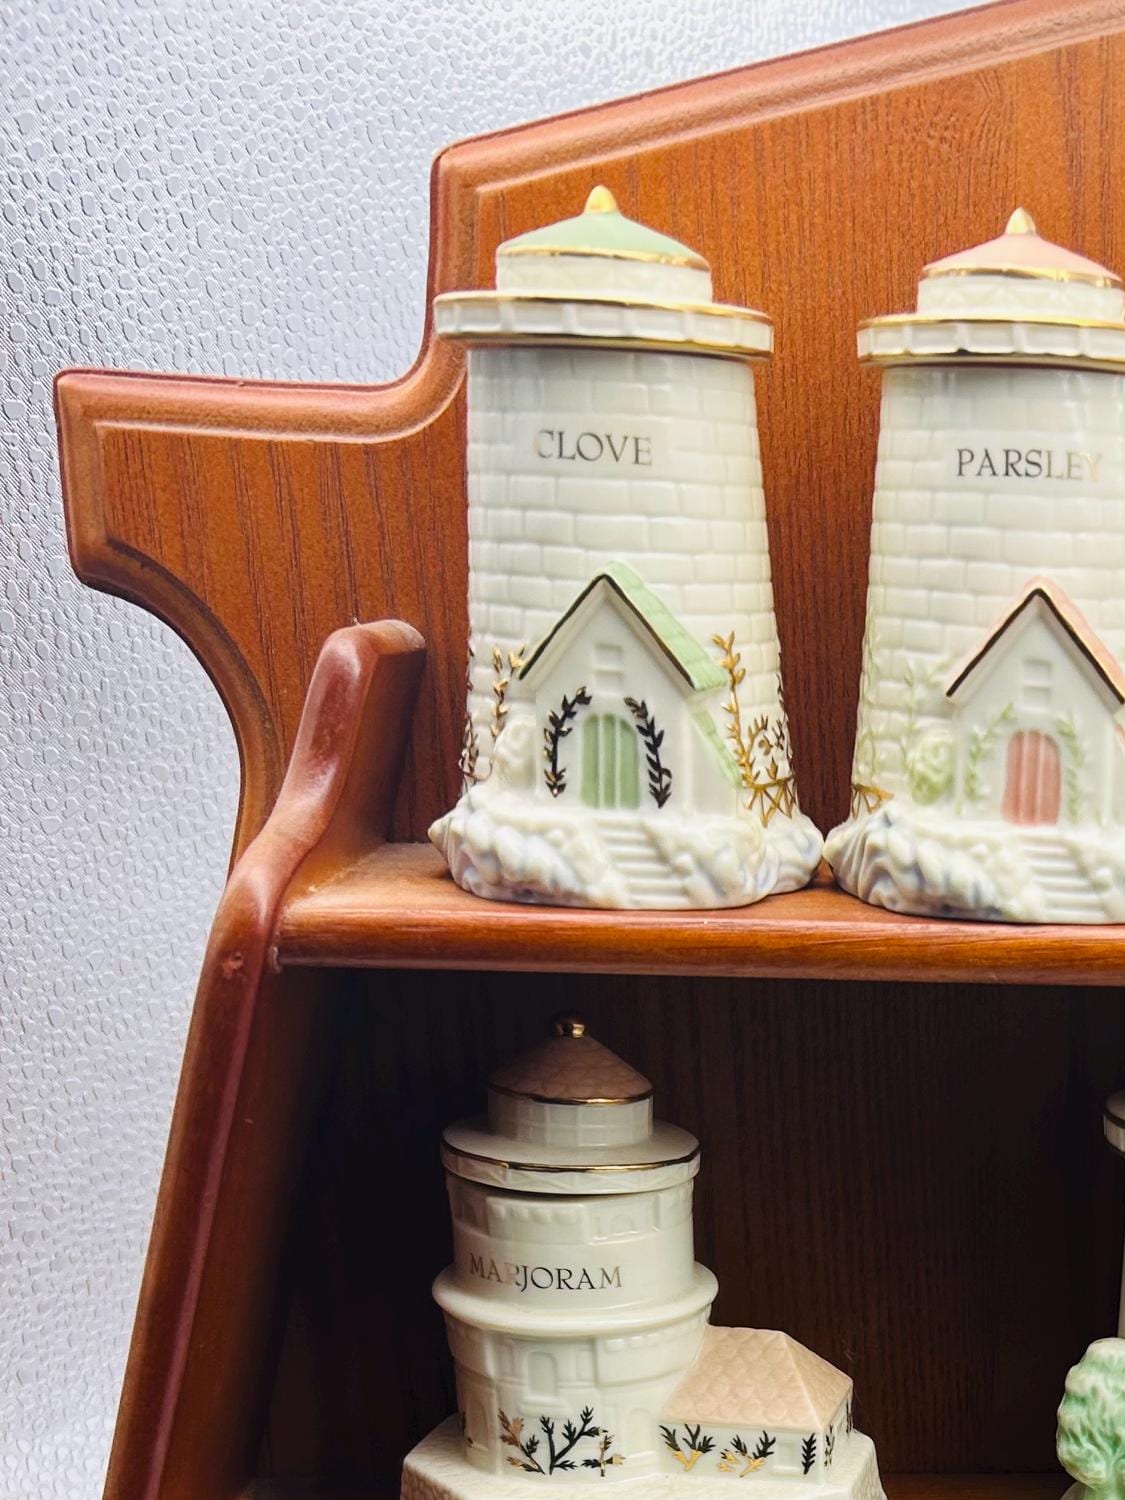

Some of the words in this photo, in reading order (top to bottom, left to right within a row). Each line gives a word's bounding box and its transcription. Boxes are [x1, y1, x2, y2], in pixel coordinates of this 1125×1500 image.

[533, 429, 652, 466] CLOVE
[957, 448, 1103, 482] PARSLEY
[469, 1252, 624, 1292] MARJORAM
